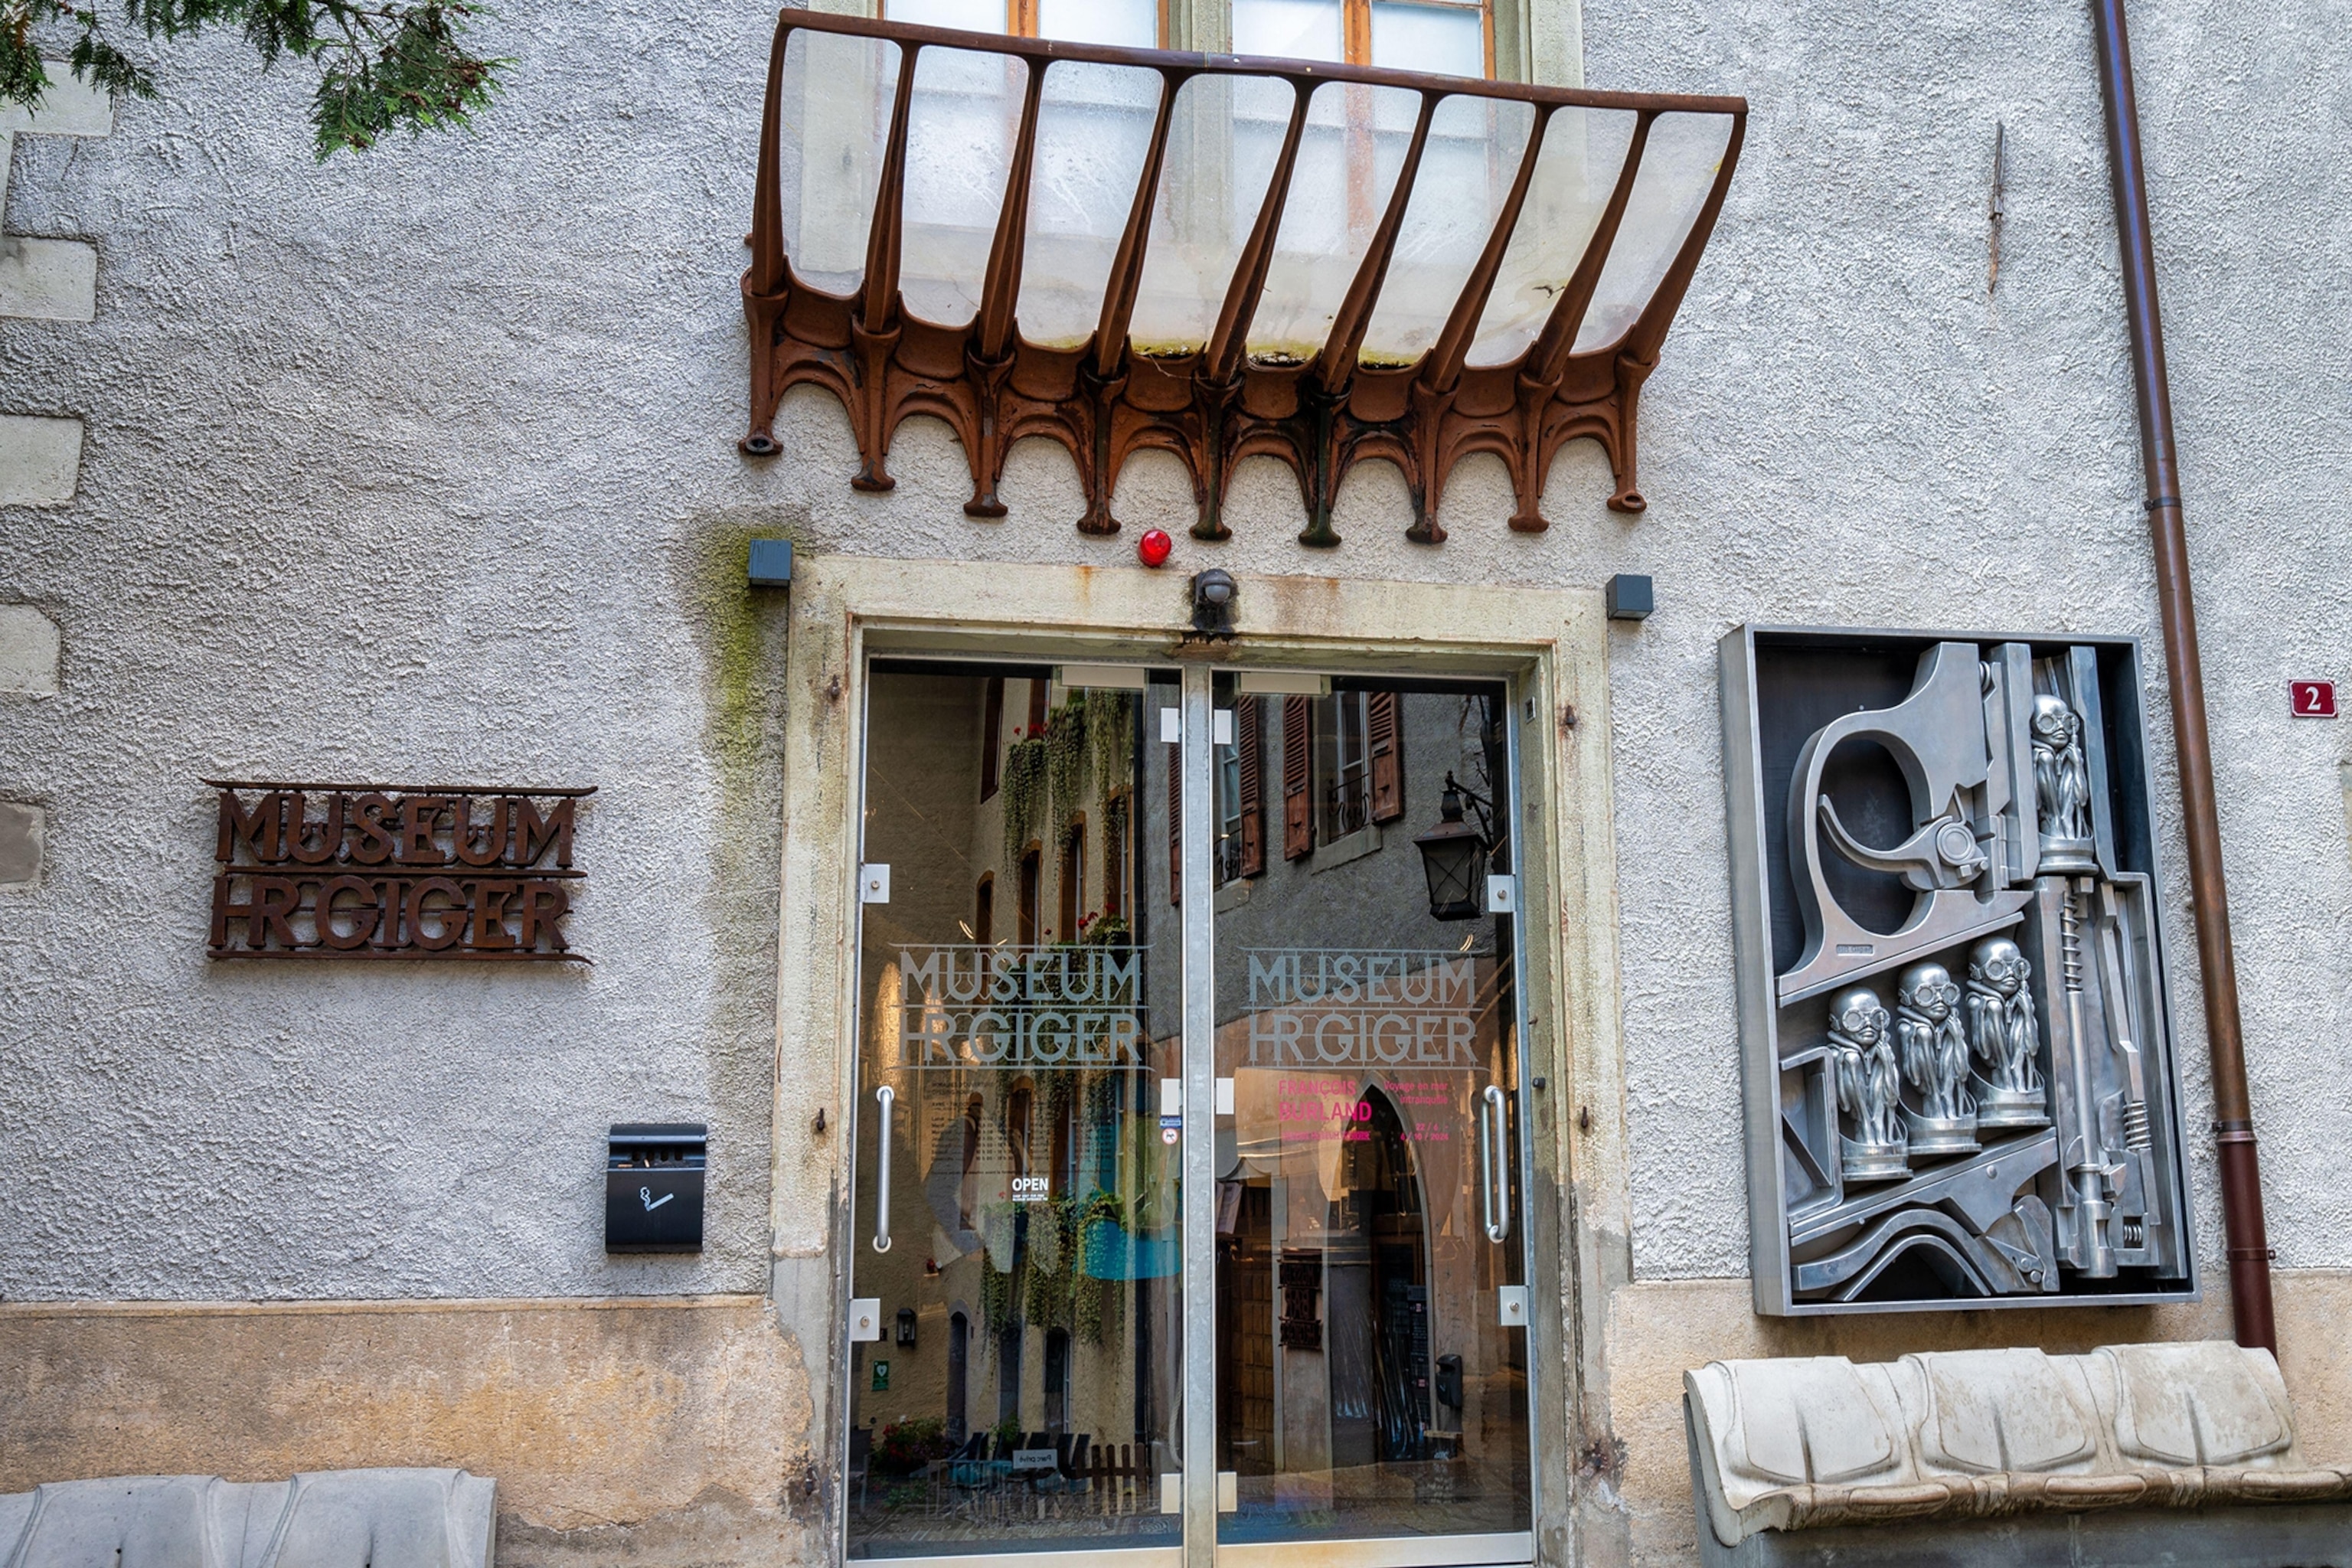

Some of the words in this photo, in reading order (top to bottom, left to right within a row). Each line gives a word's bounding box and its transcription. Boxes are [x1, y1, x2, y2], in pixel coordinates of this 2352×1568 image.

[2305, 686, 2321, 710] 2
[214, 792, 576, 867] MUSEUM
[315, 874, 570, 951] GIGER
[900, 951, 1142, 1002] MUSEUM
[1248, 955, 1476, 1004] MUSEUM
[969, 1012, 1142, 1063] GIGER
[1315, 1014, 1479, 1063] GIGER
[1278, 1080, 1357, 1098] FRANÇOIS
[1383, 1081, 1415, 1093] Voyage
[1279, 1102, 1373, 1122] BURLAND
[1011, 1178, 1049, 1191] OPEN
